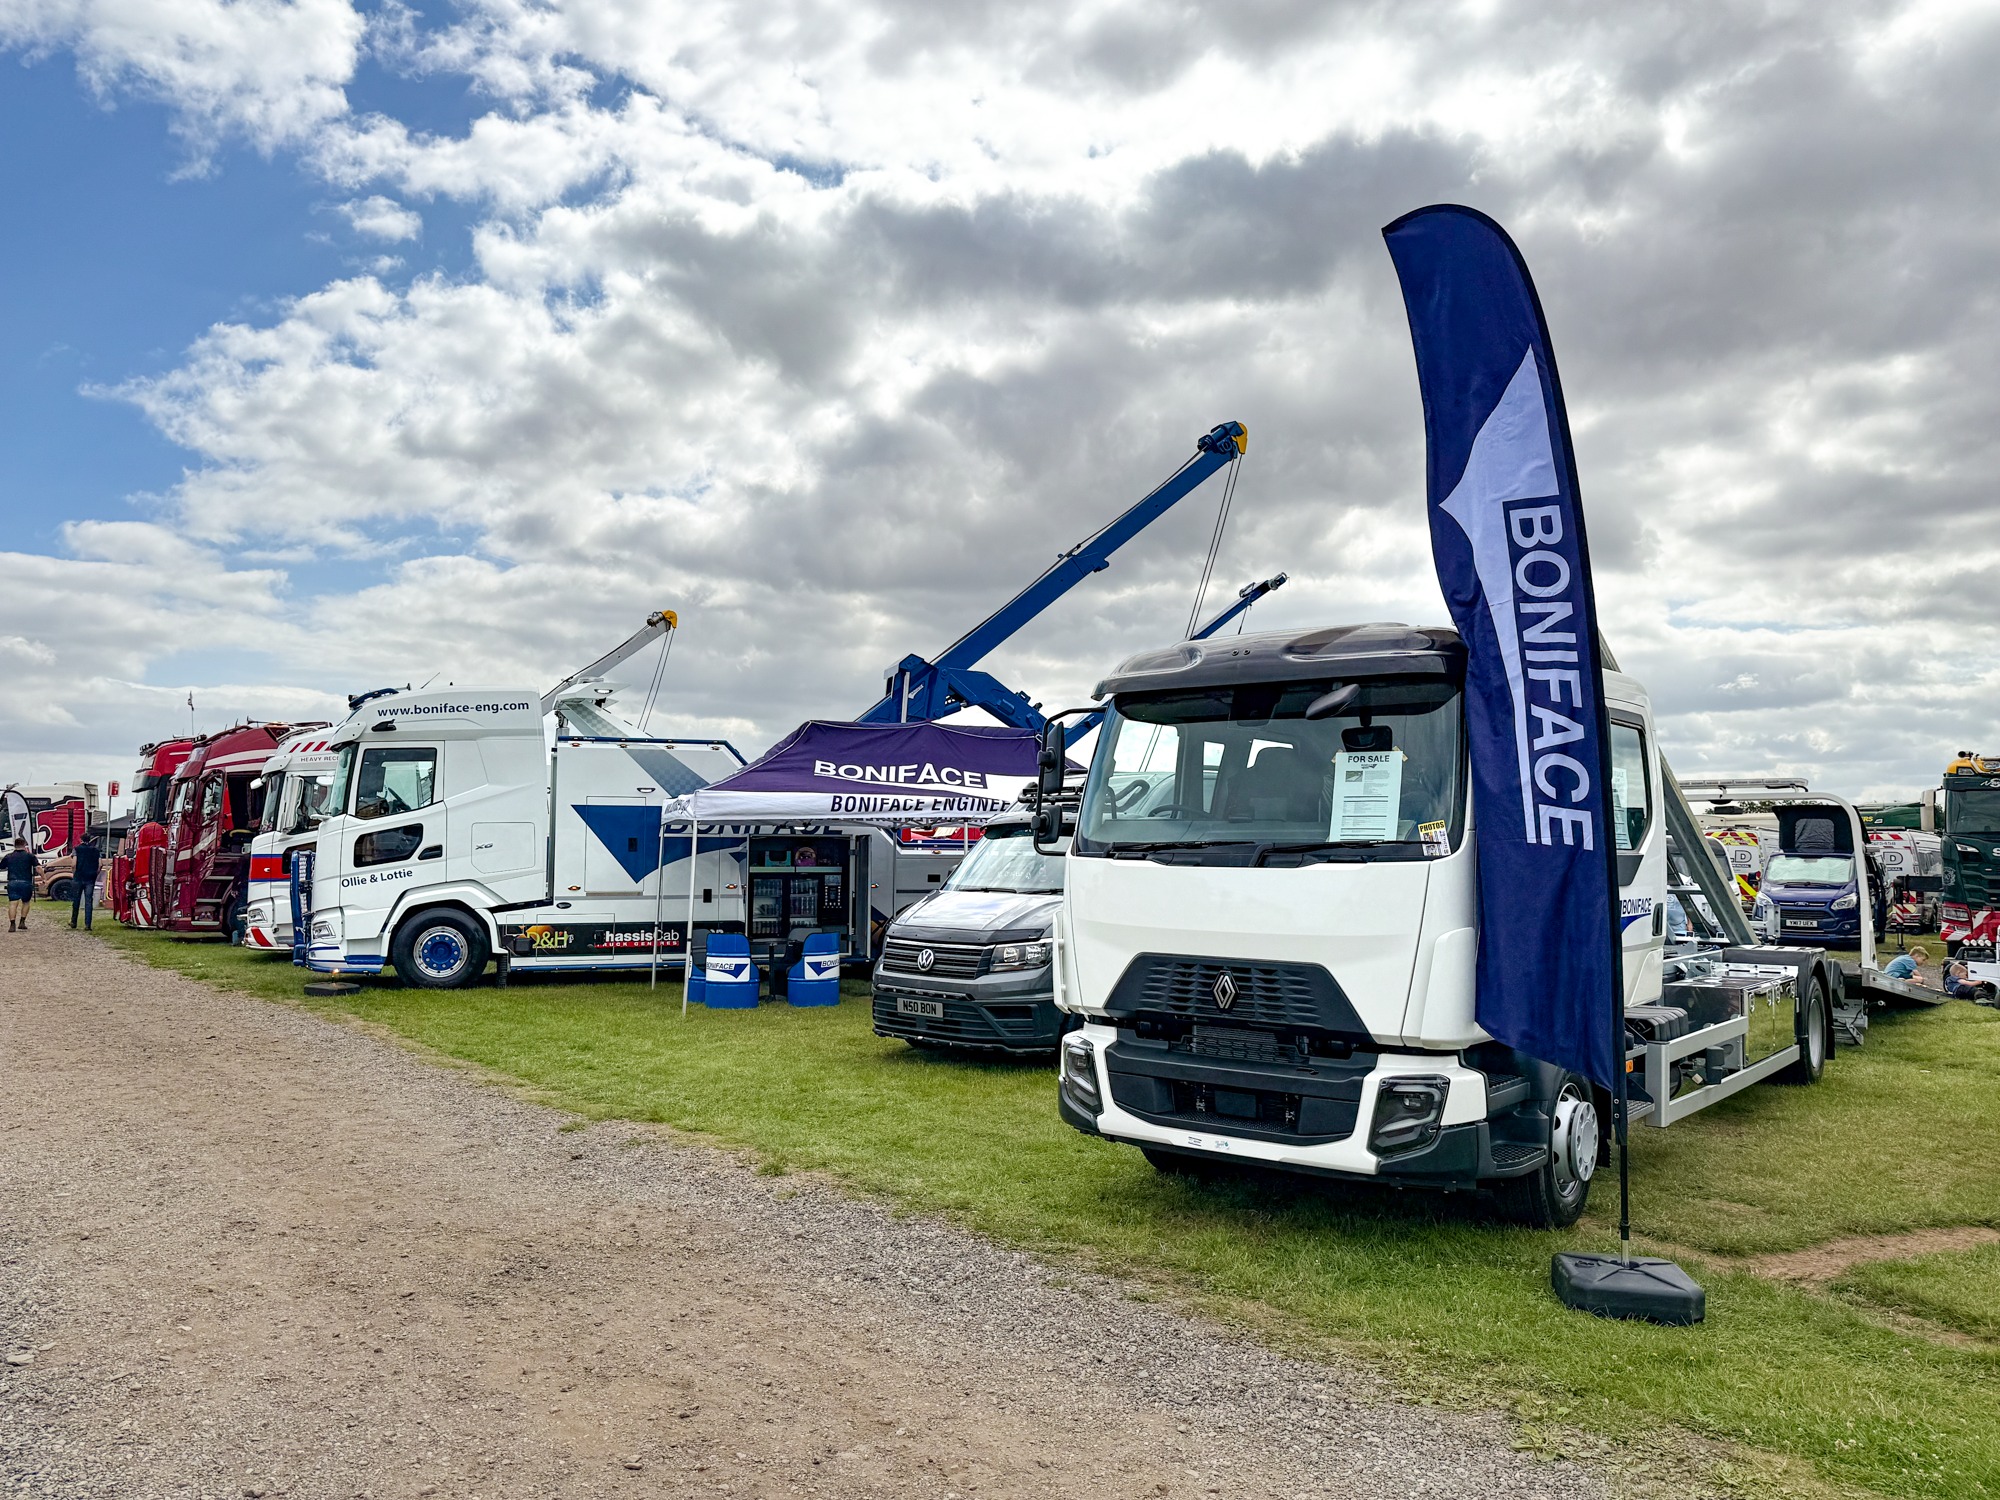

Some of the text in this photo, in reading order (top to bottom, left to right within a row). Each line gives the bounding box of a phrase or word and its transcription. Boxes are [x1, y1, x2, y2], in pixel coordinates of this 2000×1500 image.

[1509, 505, 1594, 851] BONIFACE
[378, 702, 529, 717] www.boniface-eng.com
[1368, 755, 1390, 763] SALE
[814, 760, 984, 788] BONIFACE
[831, 795, 923, 813] BONIFACE
[1420, 821, 1445, 832] PHOTOS
[341, 869, 413, 888] Ollie & Lottie
[1622, 897, 1652, 915] BONIFACE
[920, 1002, 937, 1015] BON
